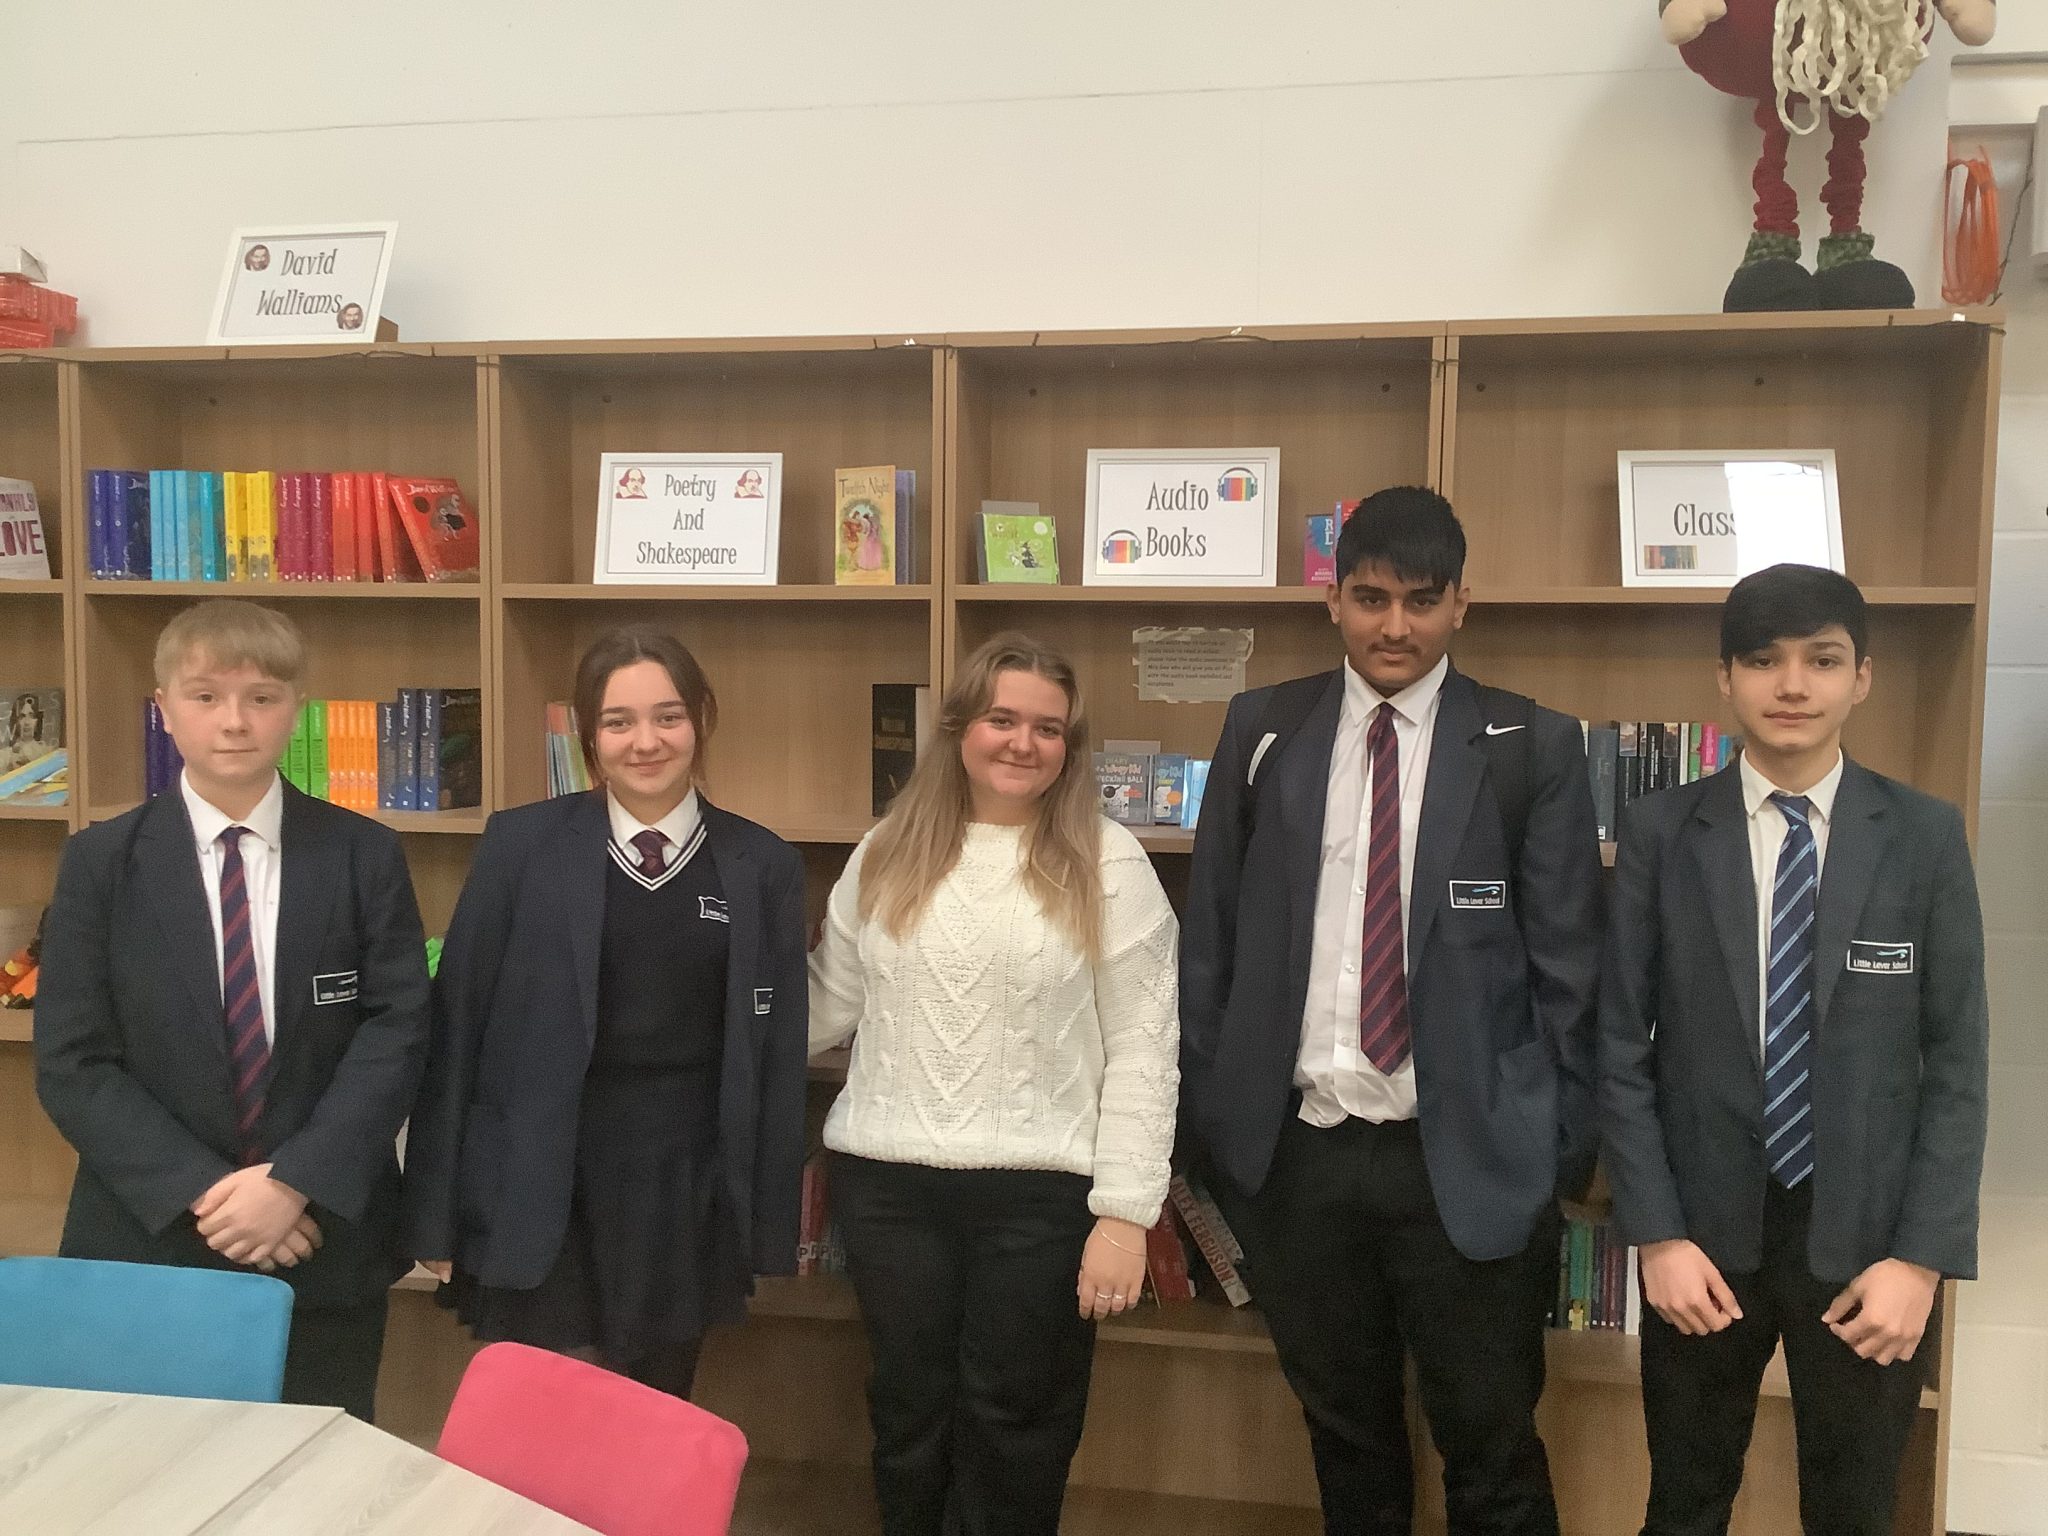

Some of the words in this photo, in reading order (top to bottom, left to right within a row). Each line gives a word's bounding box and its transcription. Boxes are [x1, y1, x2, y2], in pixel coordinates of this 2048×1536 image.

[281, 249, 338, 276] David
[256, 289, 342, 316] Walliams
[664, 474, 717, 502] Poetry
[1145, 480, 1209, 511] Audio
[673, 508, 704, 531] And
[0, 520, 43, 557] OVE
[1146, 526, 1207, 558] Books
[636, 541, 737, 570] Shakespeare
[1187, 1215, 1235, 1283] FERGUSON
